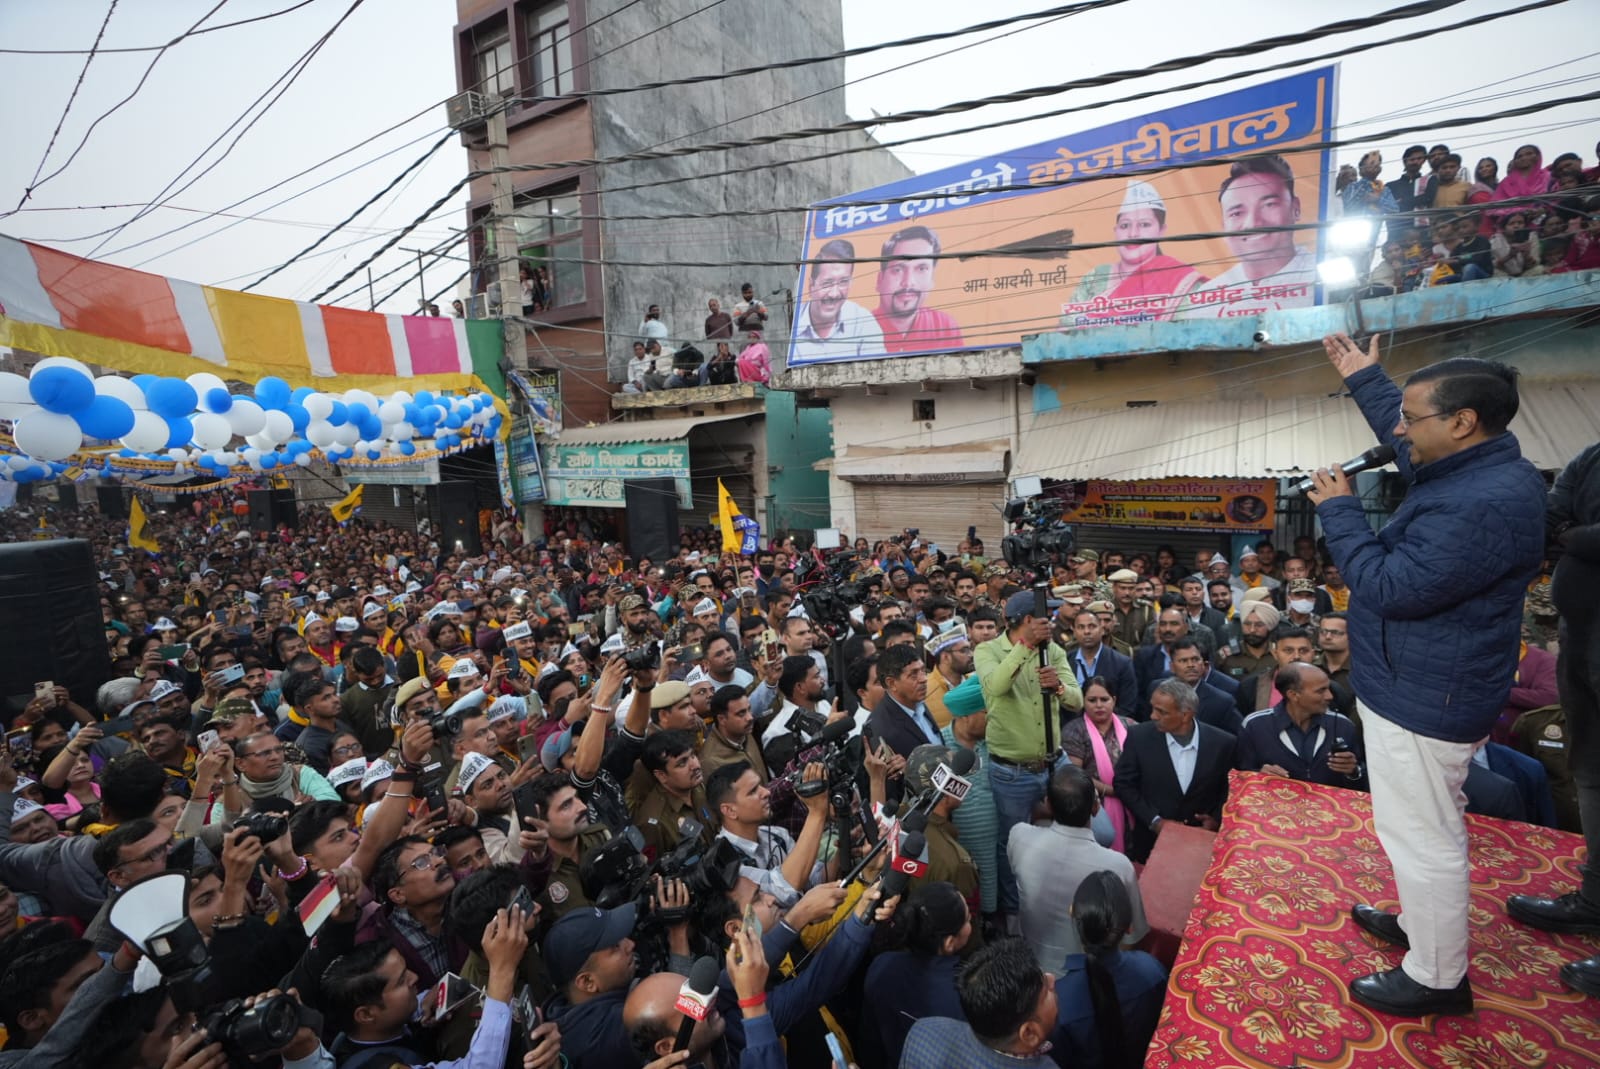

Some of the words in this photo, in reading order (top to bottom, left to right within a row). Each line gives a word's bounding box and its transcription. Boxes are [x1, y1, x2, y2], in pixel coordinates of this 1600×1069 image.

[824, 203, 889, 233] फिर
[1026, 101, 1298, 185] केजरीवाल
[963, 278, 989, 293] आम
[993, 268, 1034, 289] आदमी
[1038, 264, 1068, 286] पार्टी
[945, 780, 967, 797] ANI
